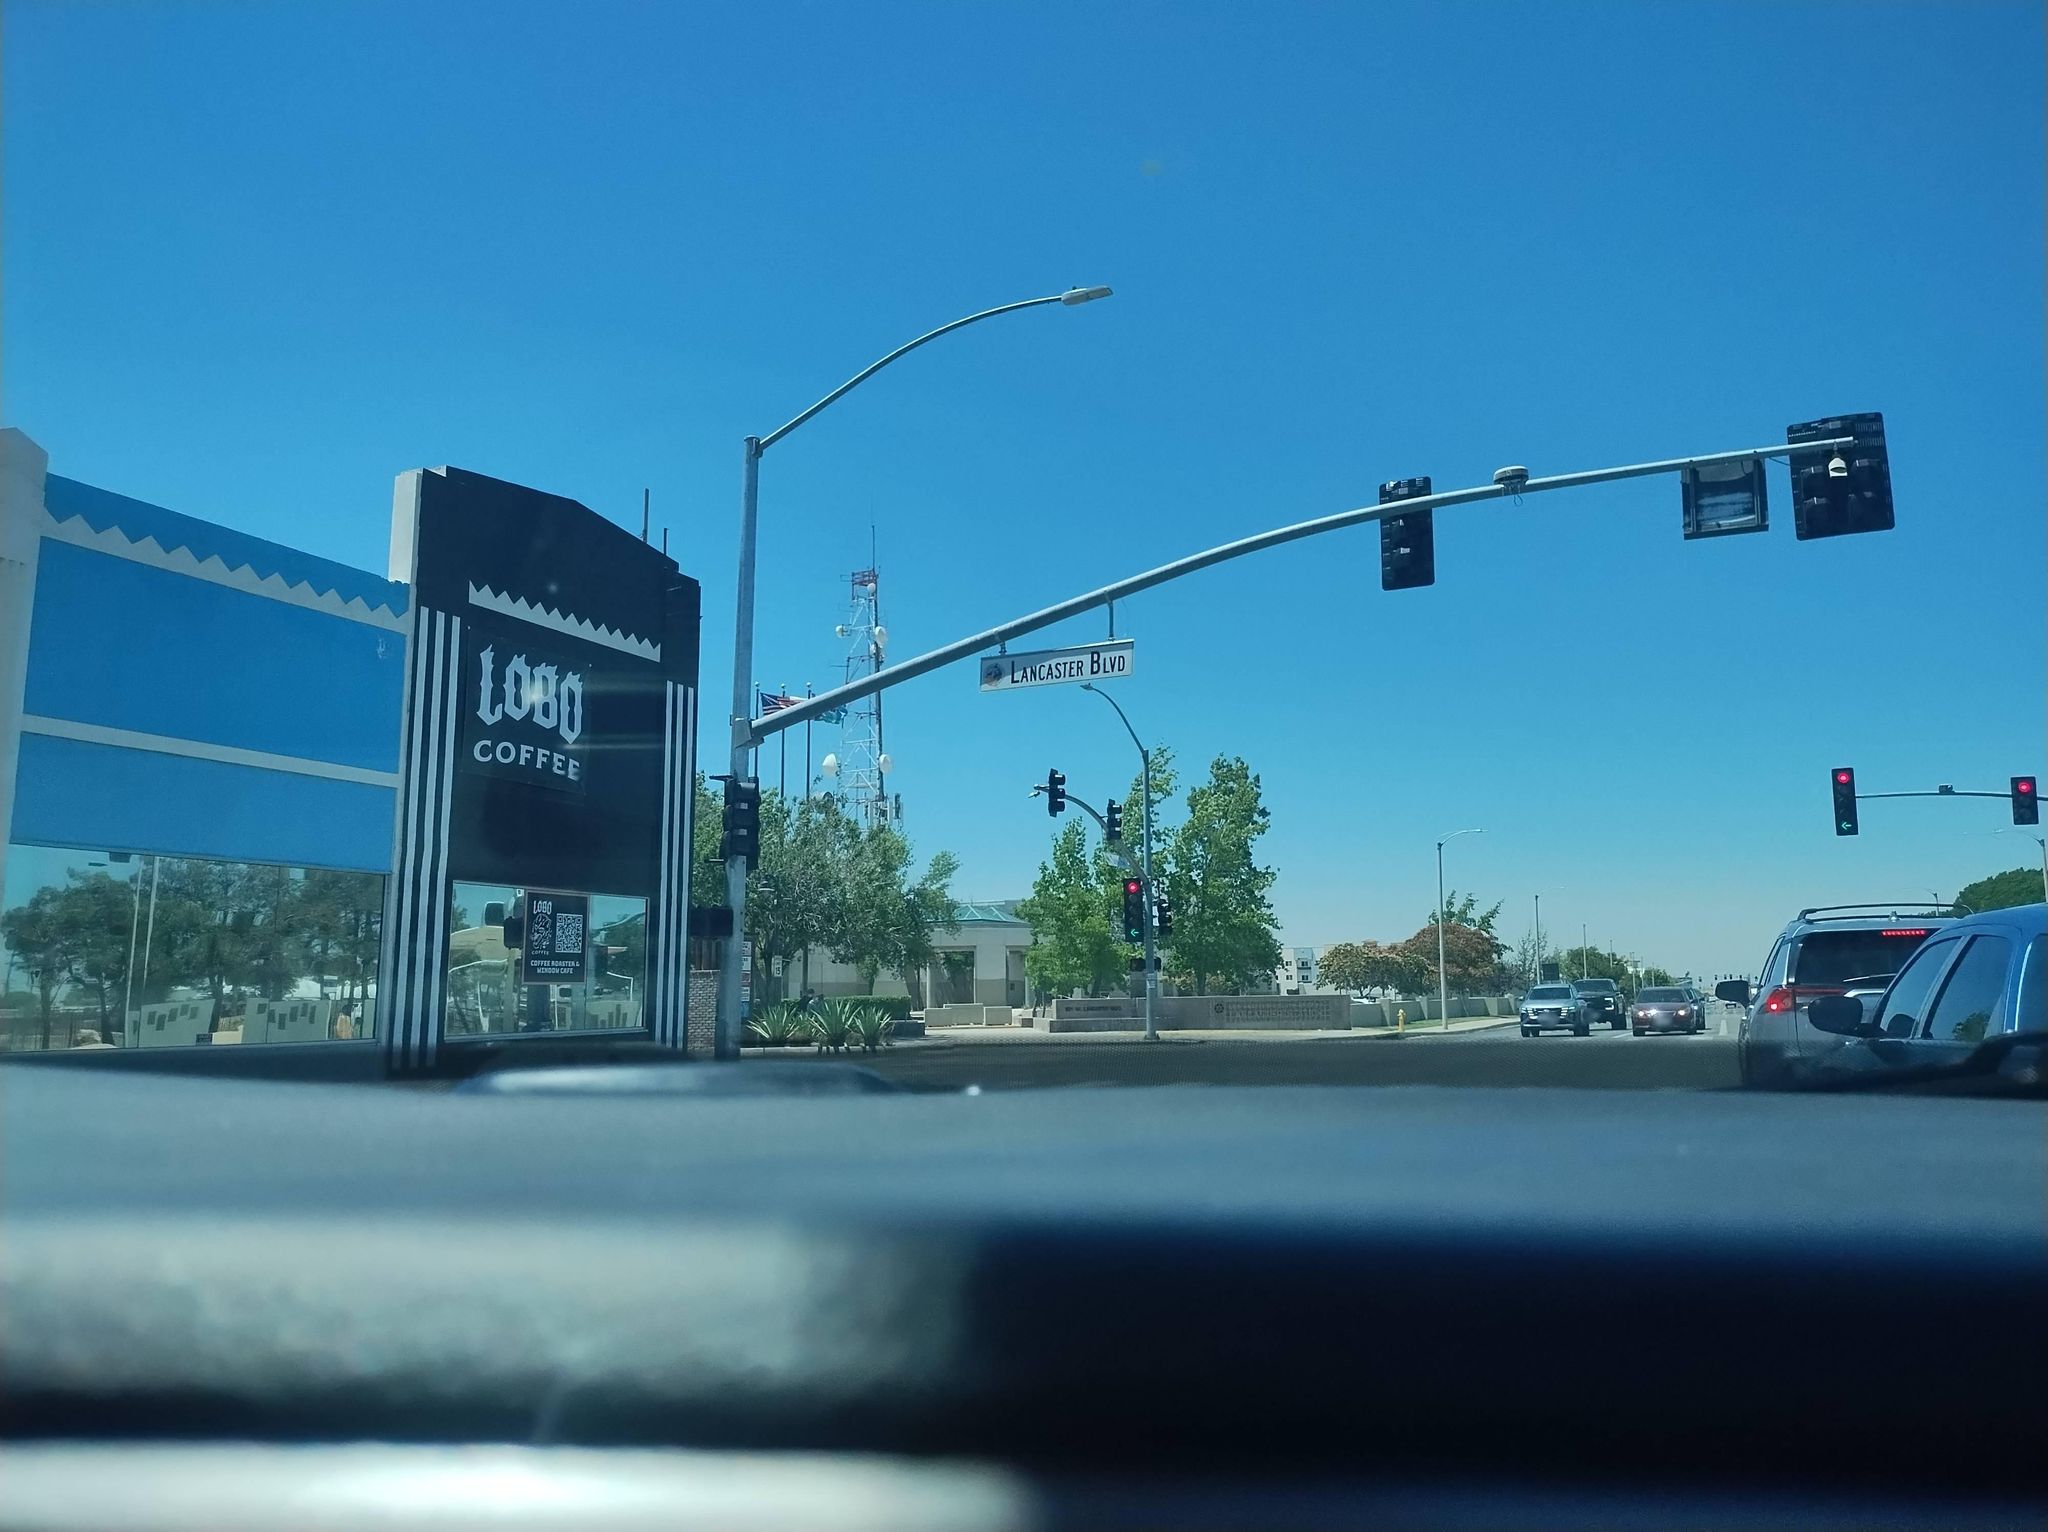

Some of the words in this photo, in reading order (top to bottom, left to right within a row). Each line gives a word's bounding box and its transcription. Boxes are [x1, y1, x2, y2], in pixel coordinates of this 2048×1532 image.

[1010, 660, 1084, 684] LANCASTER
[1090, 651, 1126, 676] BLVD
[476, 644, 583, 745] LOBO
[473, 740, 581, 782] COFFEE
[533, 900, 553, 915] LOBO
